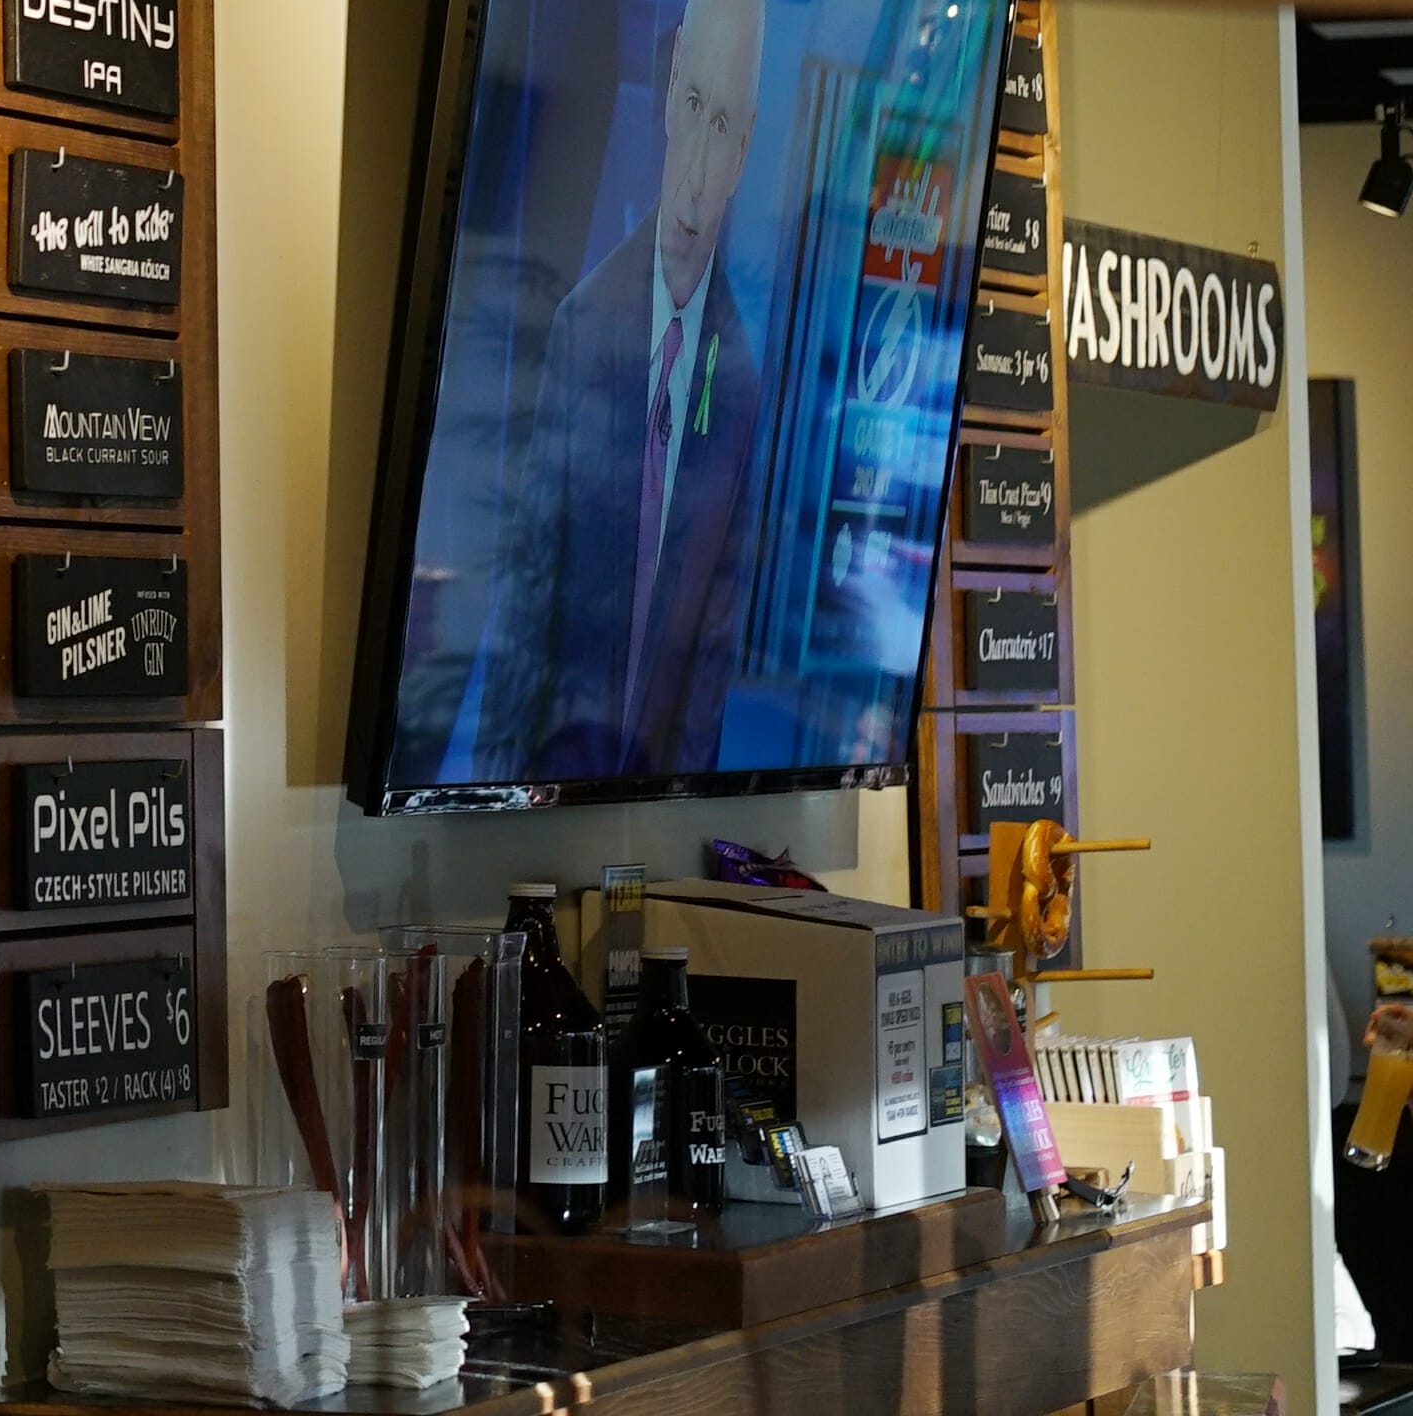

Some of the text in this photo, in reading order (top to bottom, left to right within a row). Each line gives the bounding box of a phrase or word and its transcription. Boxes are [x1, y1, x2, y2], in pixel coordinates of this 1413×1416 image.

[84, 59, 122, 96] IPA
[109, 205, 128, 245] to
[80, 254, 170, 281] WHITE SANGRIA KÖLSCH
[1014, 349, 1022, 376] 3
[43, 404, 171, 441] MOUNTAIN VIEW
[46, 446, 169, 465] BLACK CURRANT SOUR
[130, 608, 177, 645] UNRULY
[979, 628, 1037, 662] Charcuterie
[61, 626, 126, 681] PILSNER
[143, 642, 164, 677] GIN
[981, 767, 1062, 808] Sandwiches $9
[33, 787, 185, 854] Pixel Pils
[34, 869, 186, 904] CZECH-STYLE PILSNER
[38, 987, 190, 1060] SLEEVES $6
[700, 1022, 788, 1048] GGLES
[41, 1078, 89, 1112] TASTER
[95, 1076, 109, 1104] $2
[124, 1071, 157, 1101] RACK
[160, 1069, 176, 1101] (4)
[178, 1063, 191, 1092] $8
